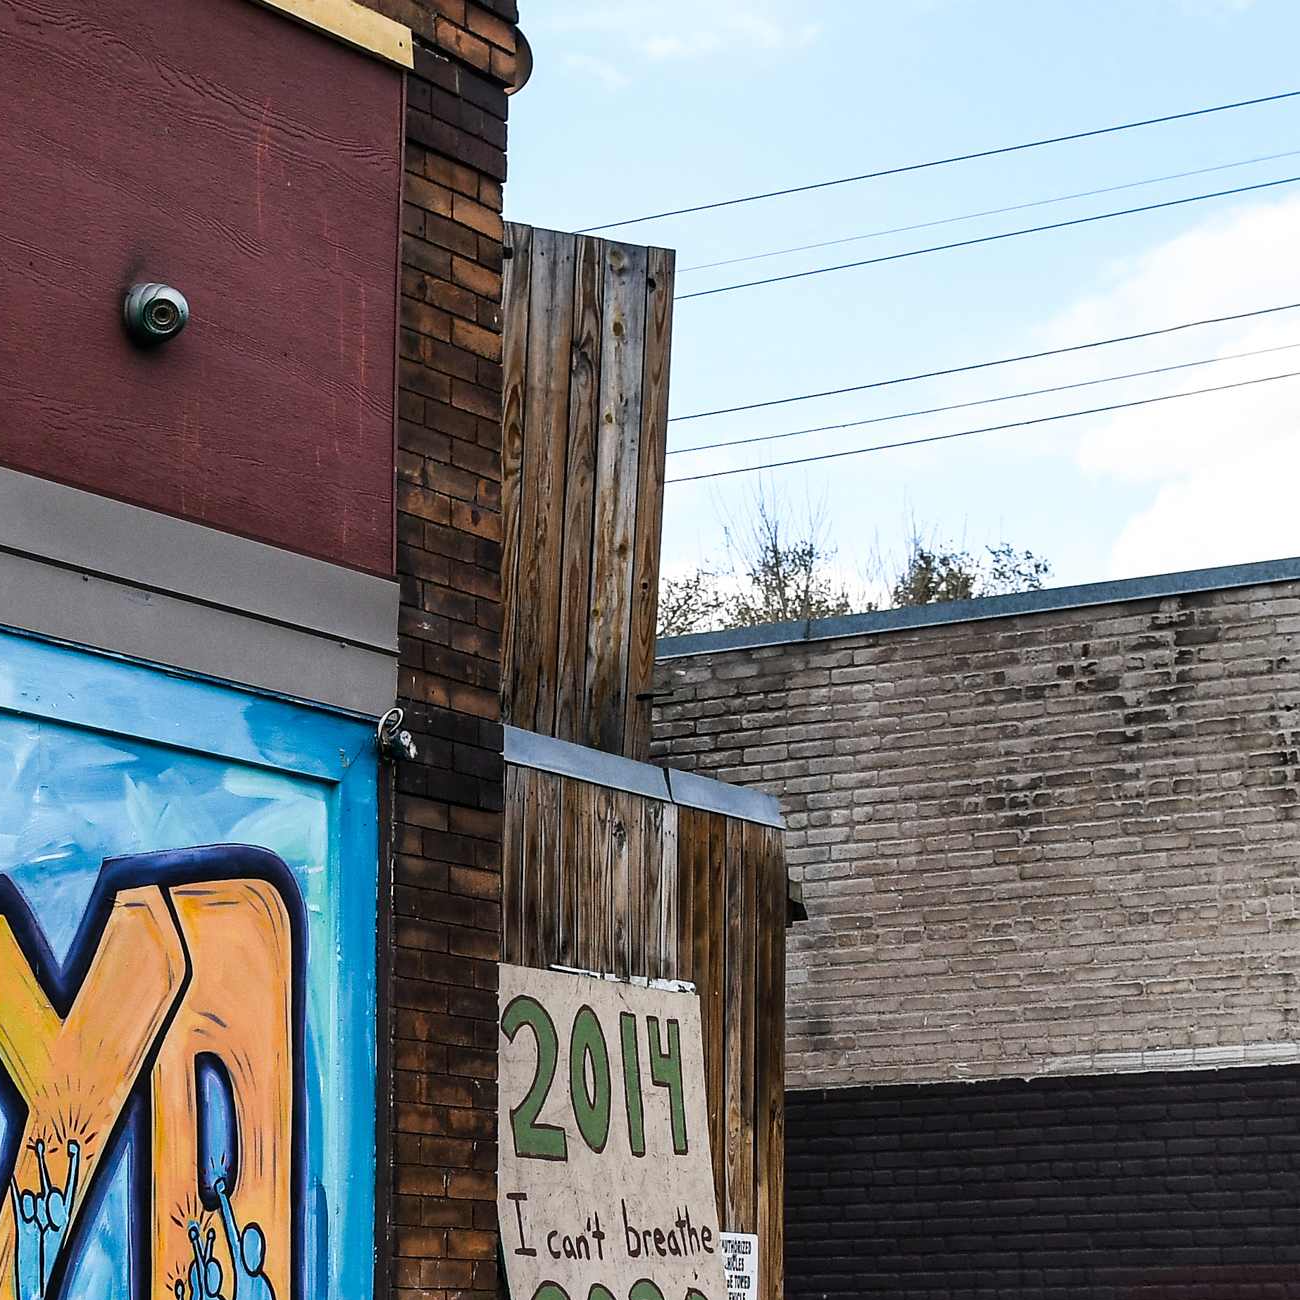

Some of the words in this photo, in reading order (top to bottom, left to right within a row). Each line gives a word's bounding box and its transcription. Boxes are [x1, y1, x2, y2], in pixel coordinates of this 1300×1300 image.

[500, 995, 689, 1162] 2014
[506, 1192, 537, 1257] I
[547, 1211, 605, 1260] can't
[621, 1198, 714, 1259] breathe
